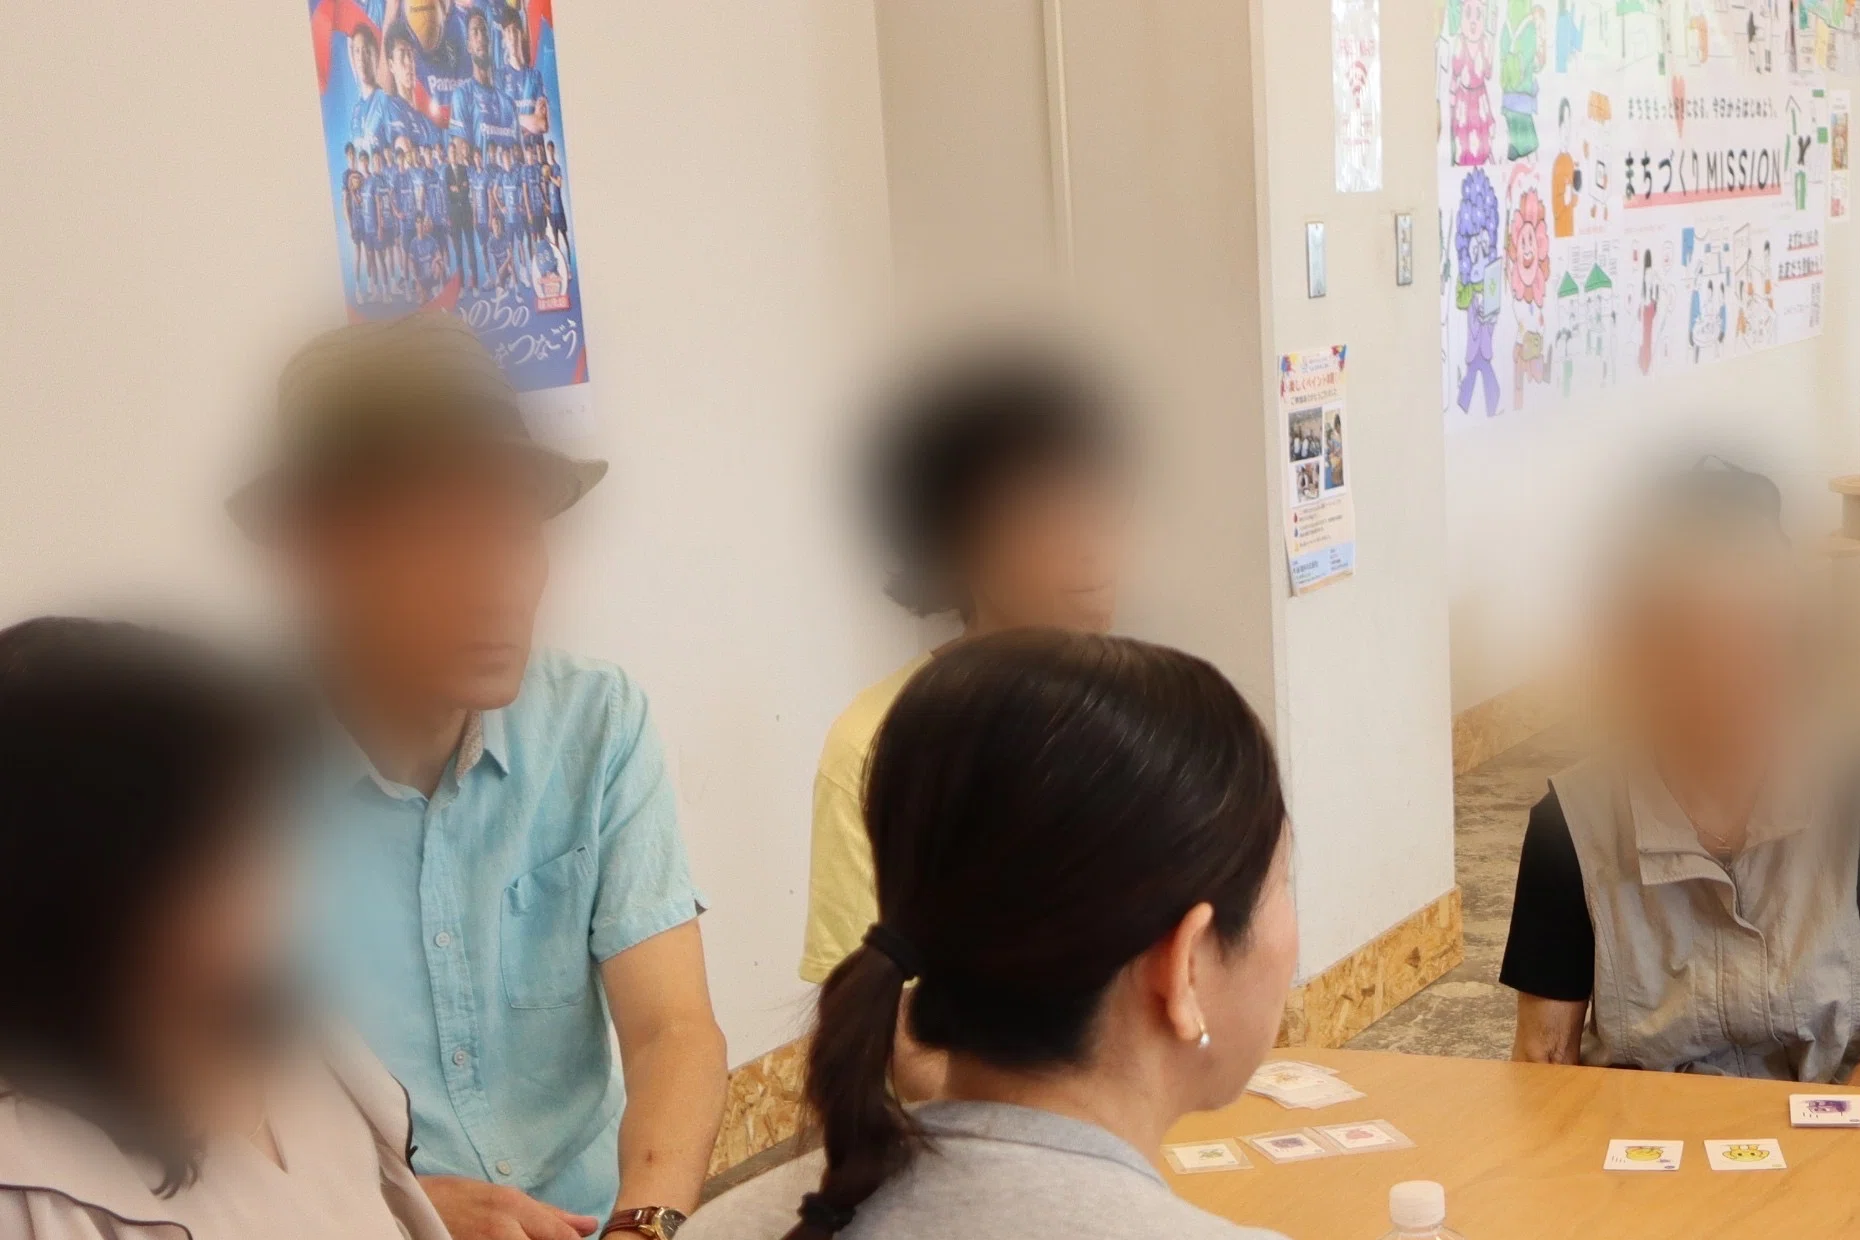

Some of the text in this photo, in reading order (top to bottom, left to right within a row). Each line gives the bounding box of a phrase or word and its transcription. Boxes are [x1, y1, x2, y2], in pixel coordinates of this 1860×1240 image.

[1625, 148, 1780, 200] まちづくり MISSION
